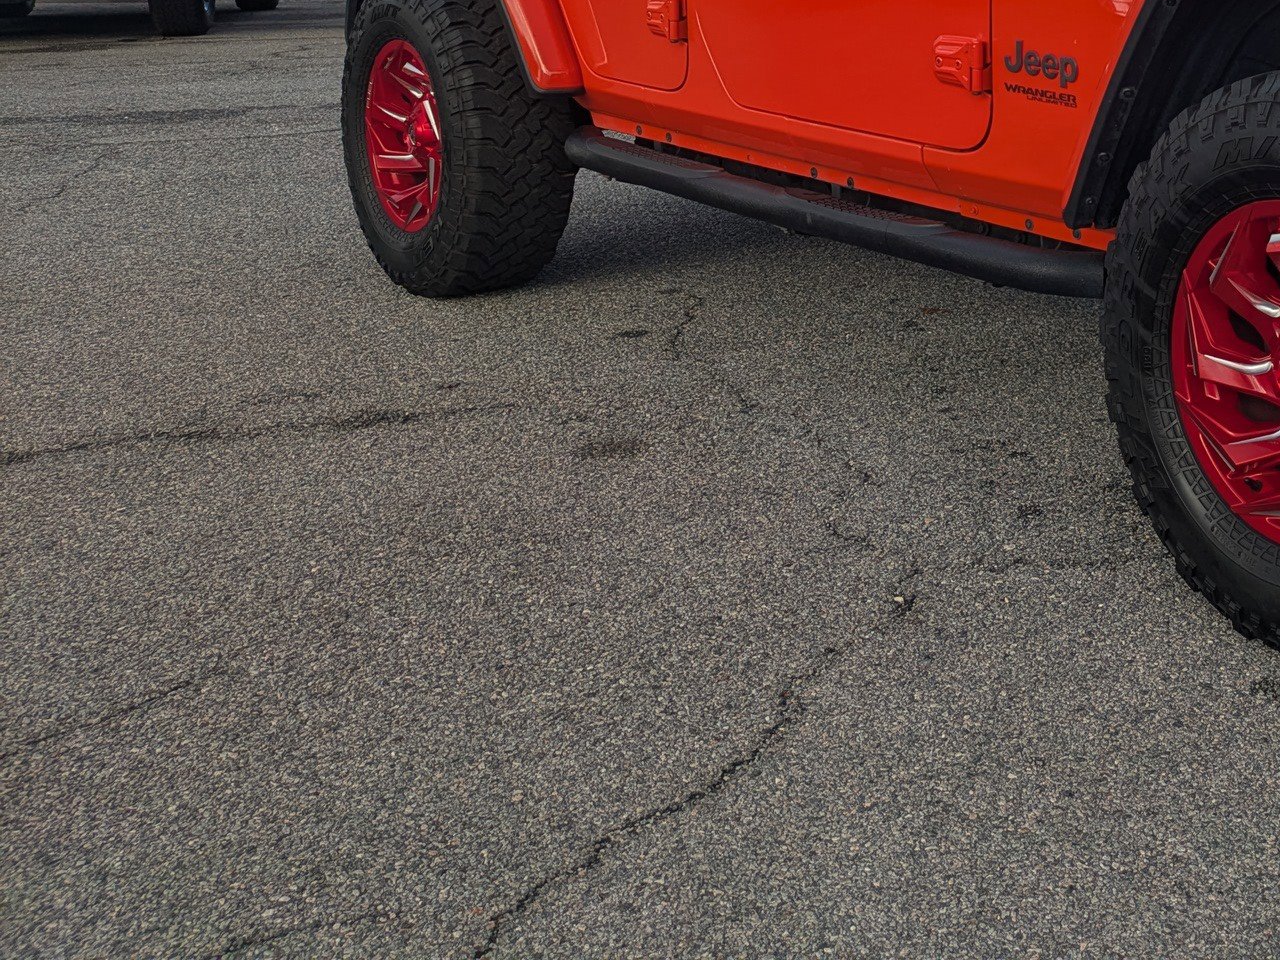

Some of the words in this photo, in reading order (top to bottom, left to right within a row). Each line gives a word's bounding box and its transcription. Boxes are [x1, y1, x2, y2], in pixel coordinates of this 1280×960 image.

[1004, 39, 1079, 89] Jeep
[1004, 82, 1077, 104] WRANGLER
[1026, 95, 1078, 109] UNLIMITED
